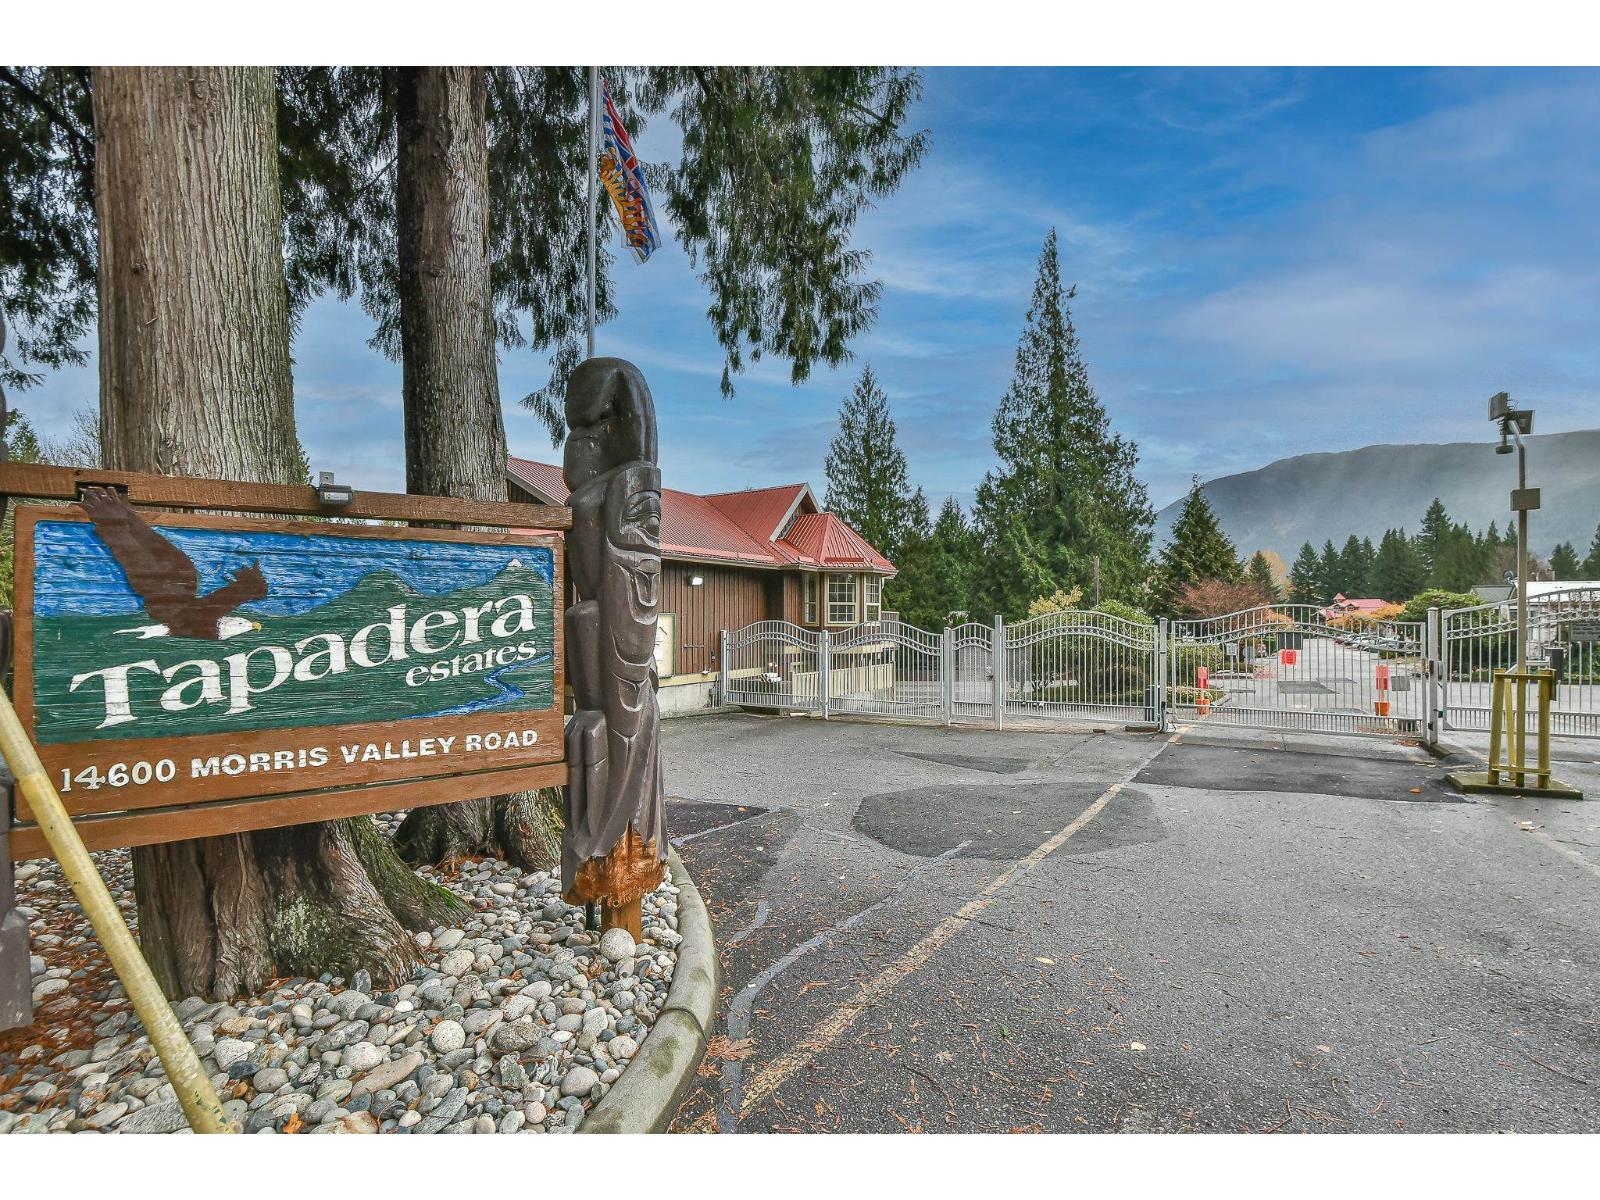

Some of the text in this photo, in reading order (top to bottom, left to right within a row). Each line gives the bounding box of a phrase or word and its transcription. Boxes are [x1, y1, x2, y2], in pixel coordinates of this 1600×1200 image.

[69, 594, 536, 729] Tapadera
[405, 640, 537, 687] estates
[60, 729, 538, 792] 14600 MORRIS VALLEY ROAD
